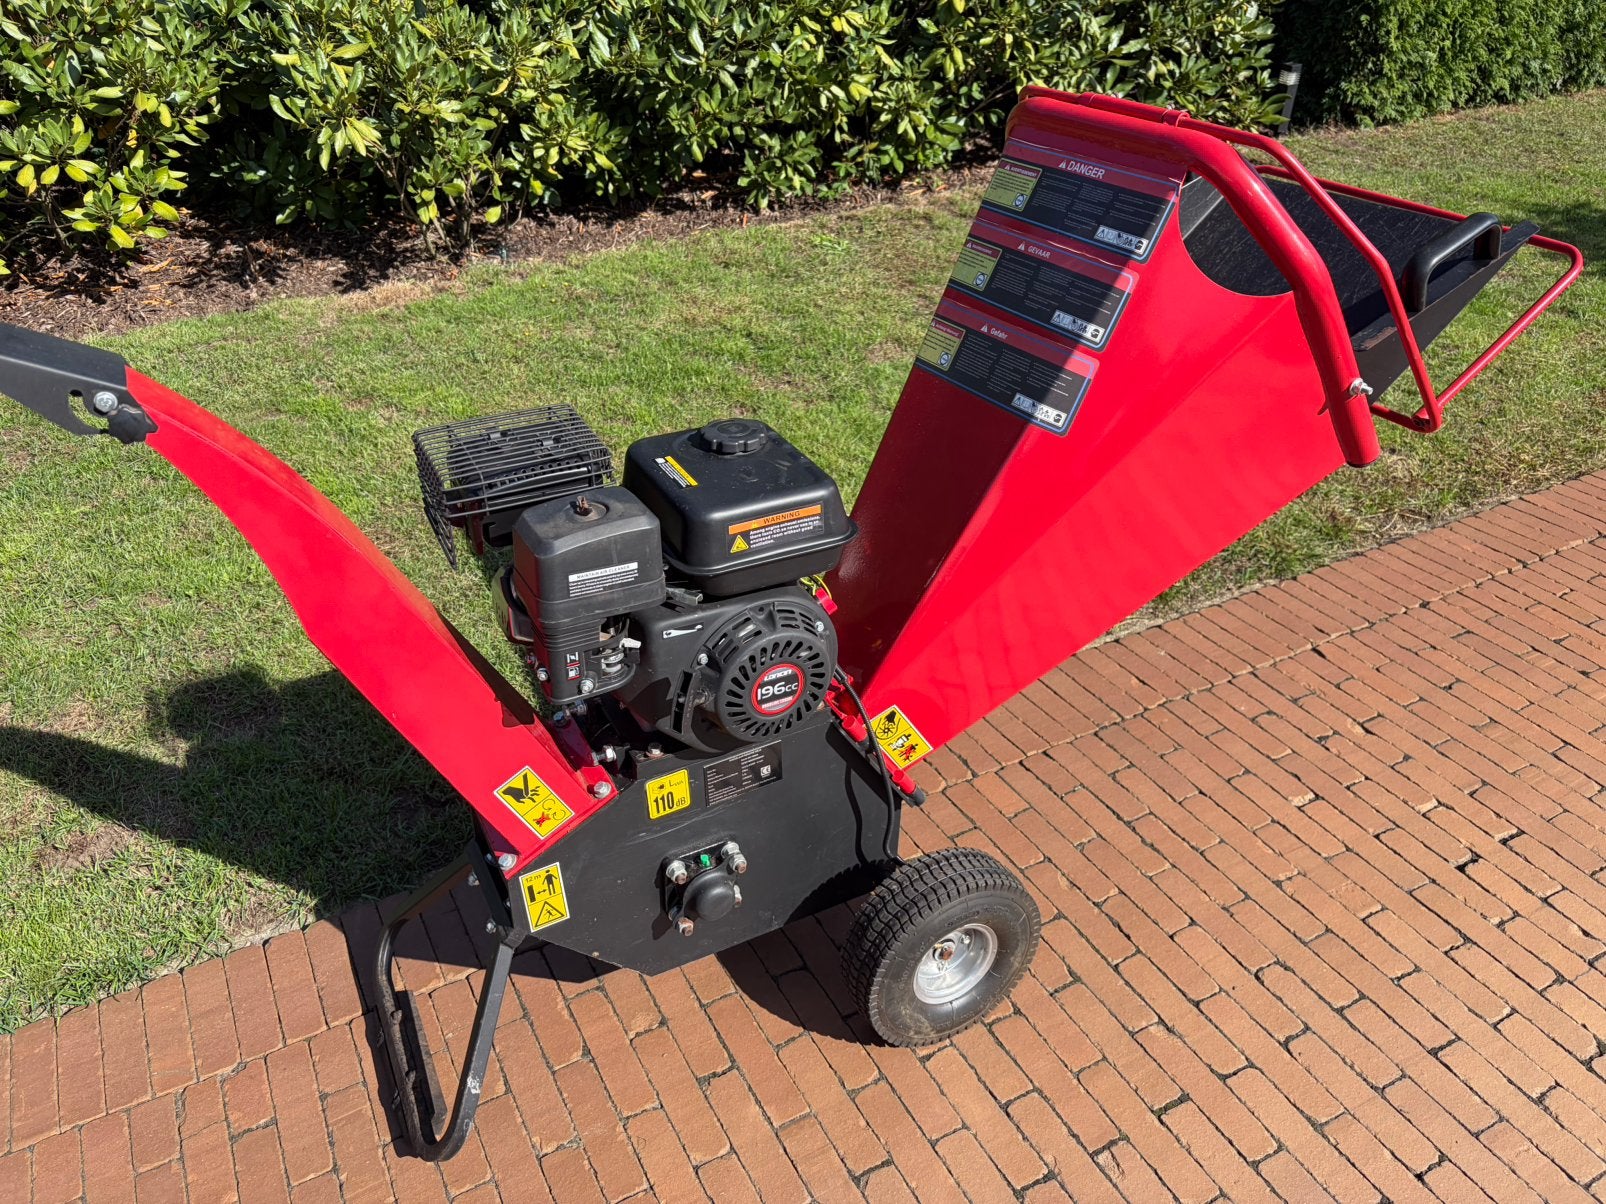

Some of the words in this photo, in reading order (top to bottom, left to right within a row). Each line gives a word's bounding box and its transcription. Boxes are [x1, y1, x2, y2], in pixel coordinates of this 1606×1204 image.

[1066, 160, 1105, 179] DANGER
[1028, 245, 1051, 258] GEVAAR
[991, 327, 1008, 339] Gefahr
[763, 511, 800, 524] WARNING
[784, 527, 801, 537] without
[609, 565, 630, 573] CLEANER
[757, 681, 798, 700] 196cc
[653, 791, 675, 813] 110
[675, 796, 686, 807] dB
